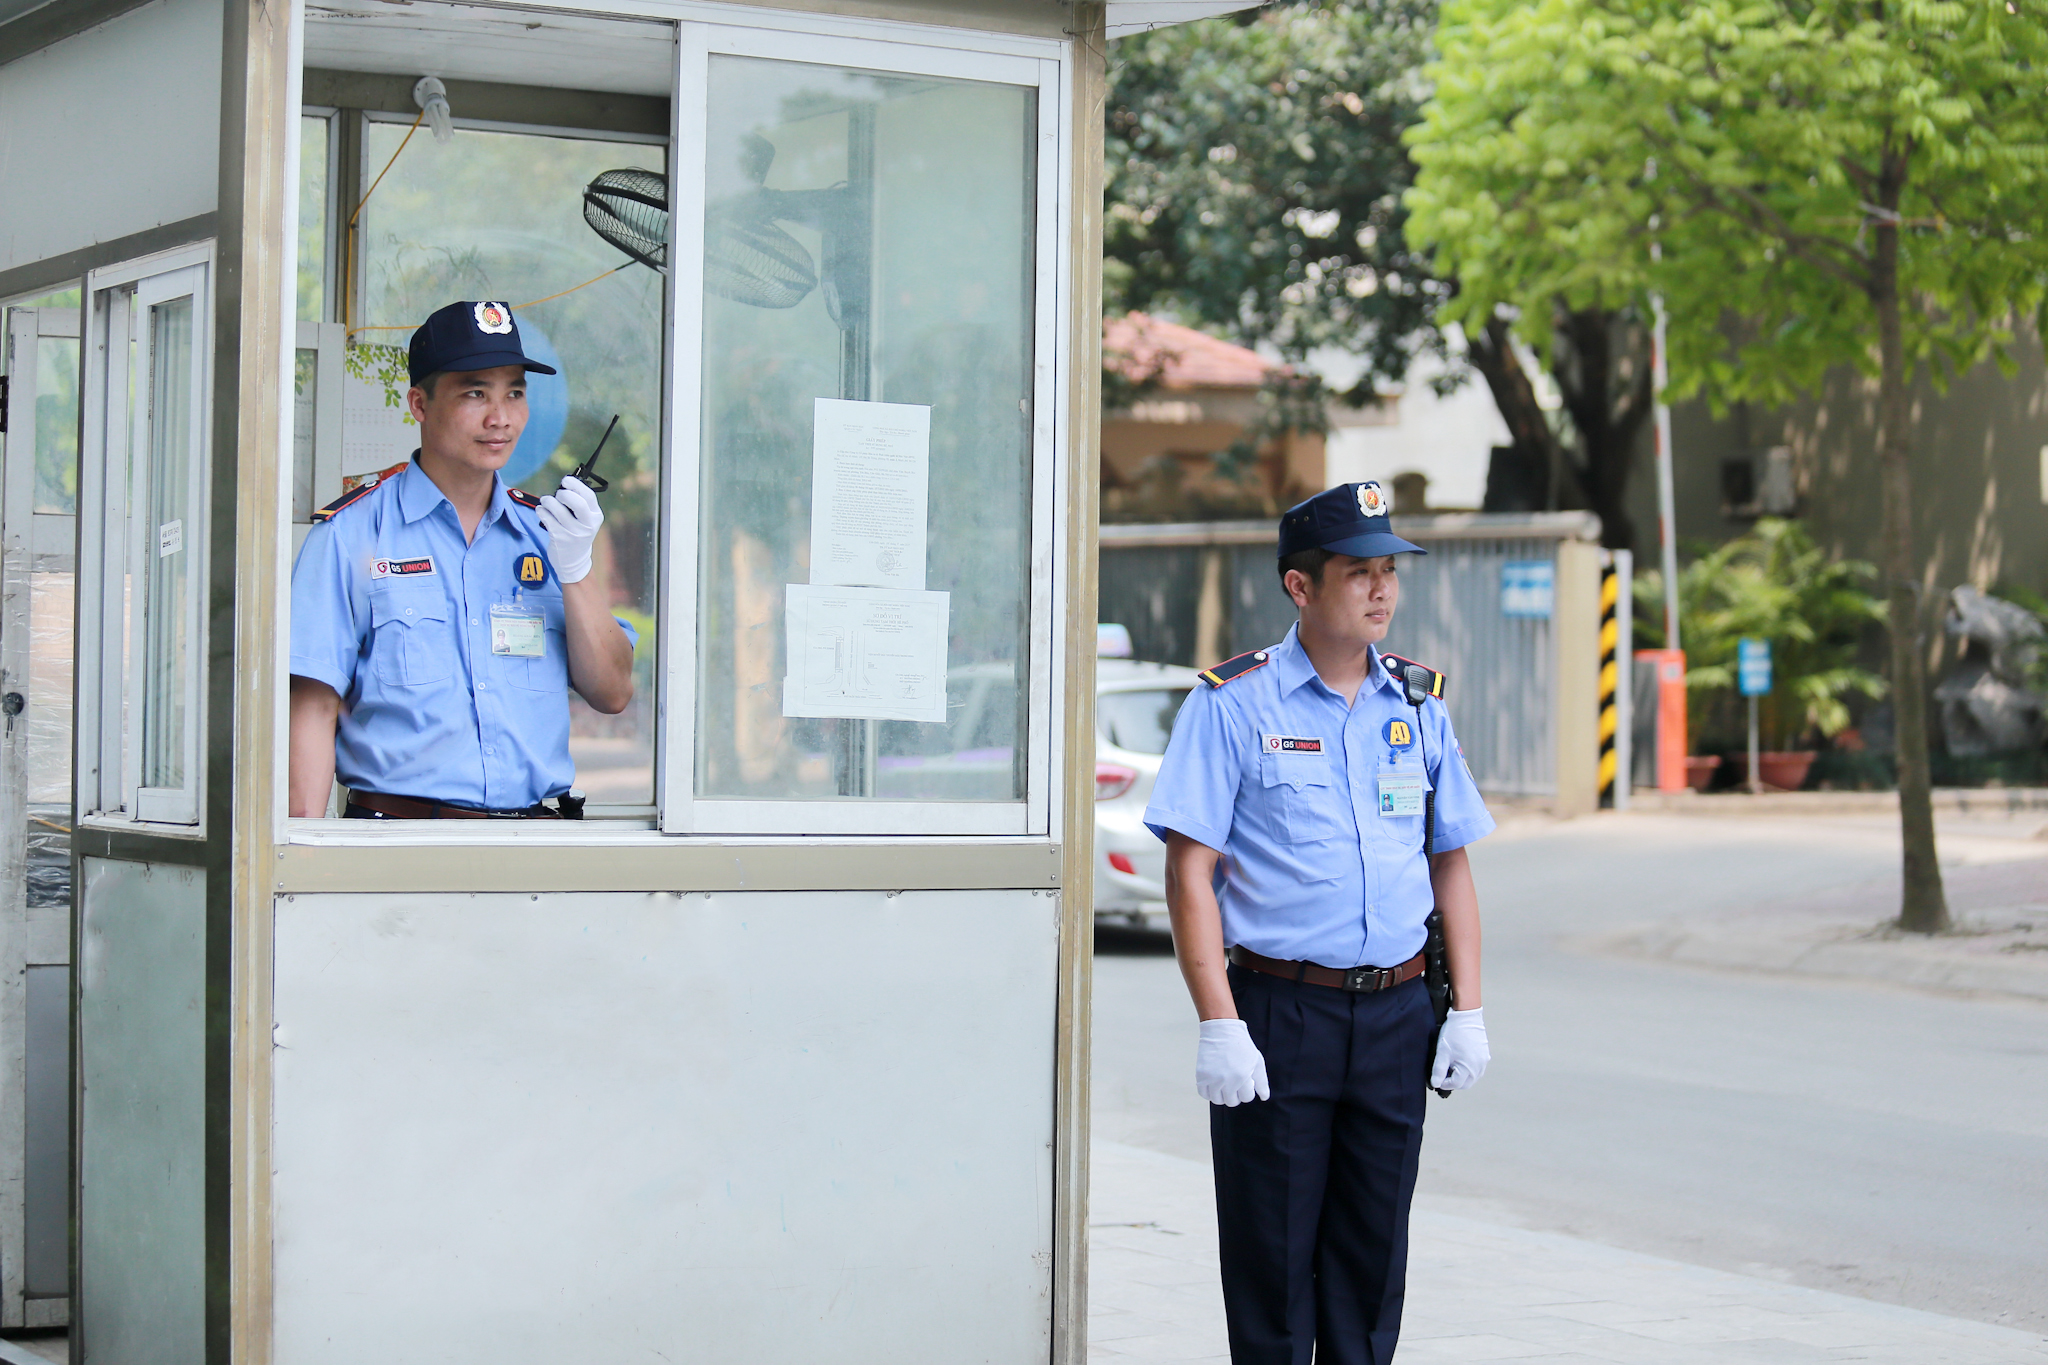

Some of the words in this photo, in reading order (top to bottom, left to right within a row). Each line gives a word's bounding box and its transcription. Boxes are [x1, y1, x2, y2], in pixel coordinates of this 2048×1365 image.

[391, 563, 402, 573] G5
[402, 562, 431, 572] UNION
[1283, 741, 1294, 749] G5
[1294, 741, 1320, 750] UNION
